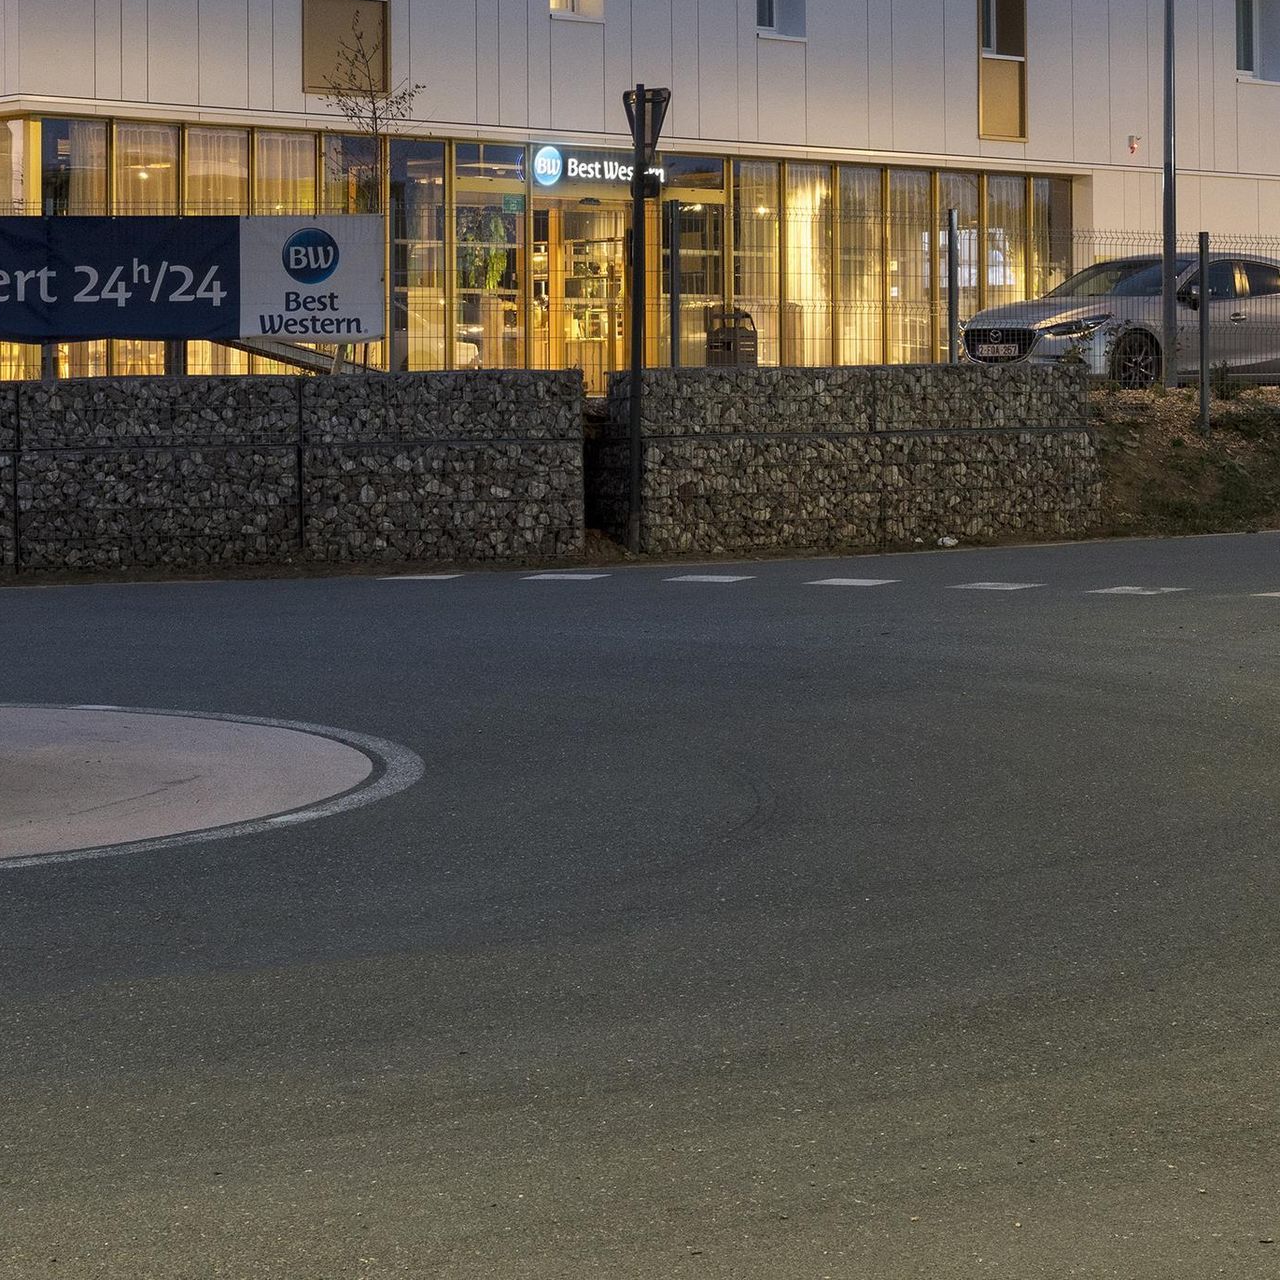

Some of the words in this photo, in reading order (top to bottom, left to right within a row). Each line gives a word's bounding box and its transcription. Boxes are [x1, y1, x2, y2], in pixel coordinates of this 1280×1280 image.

[567, 158, 601, 179] Best
[602, 161, 665, 183] Wesn
[288, 246, 334, 269] BW
[72, 257, 228, 308] 24h/24
[284, 291, 340, 312] Best
[259, 313, 363, 335] Western
